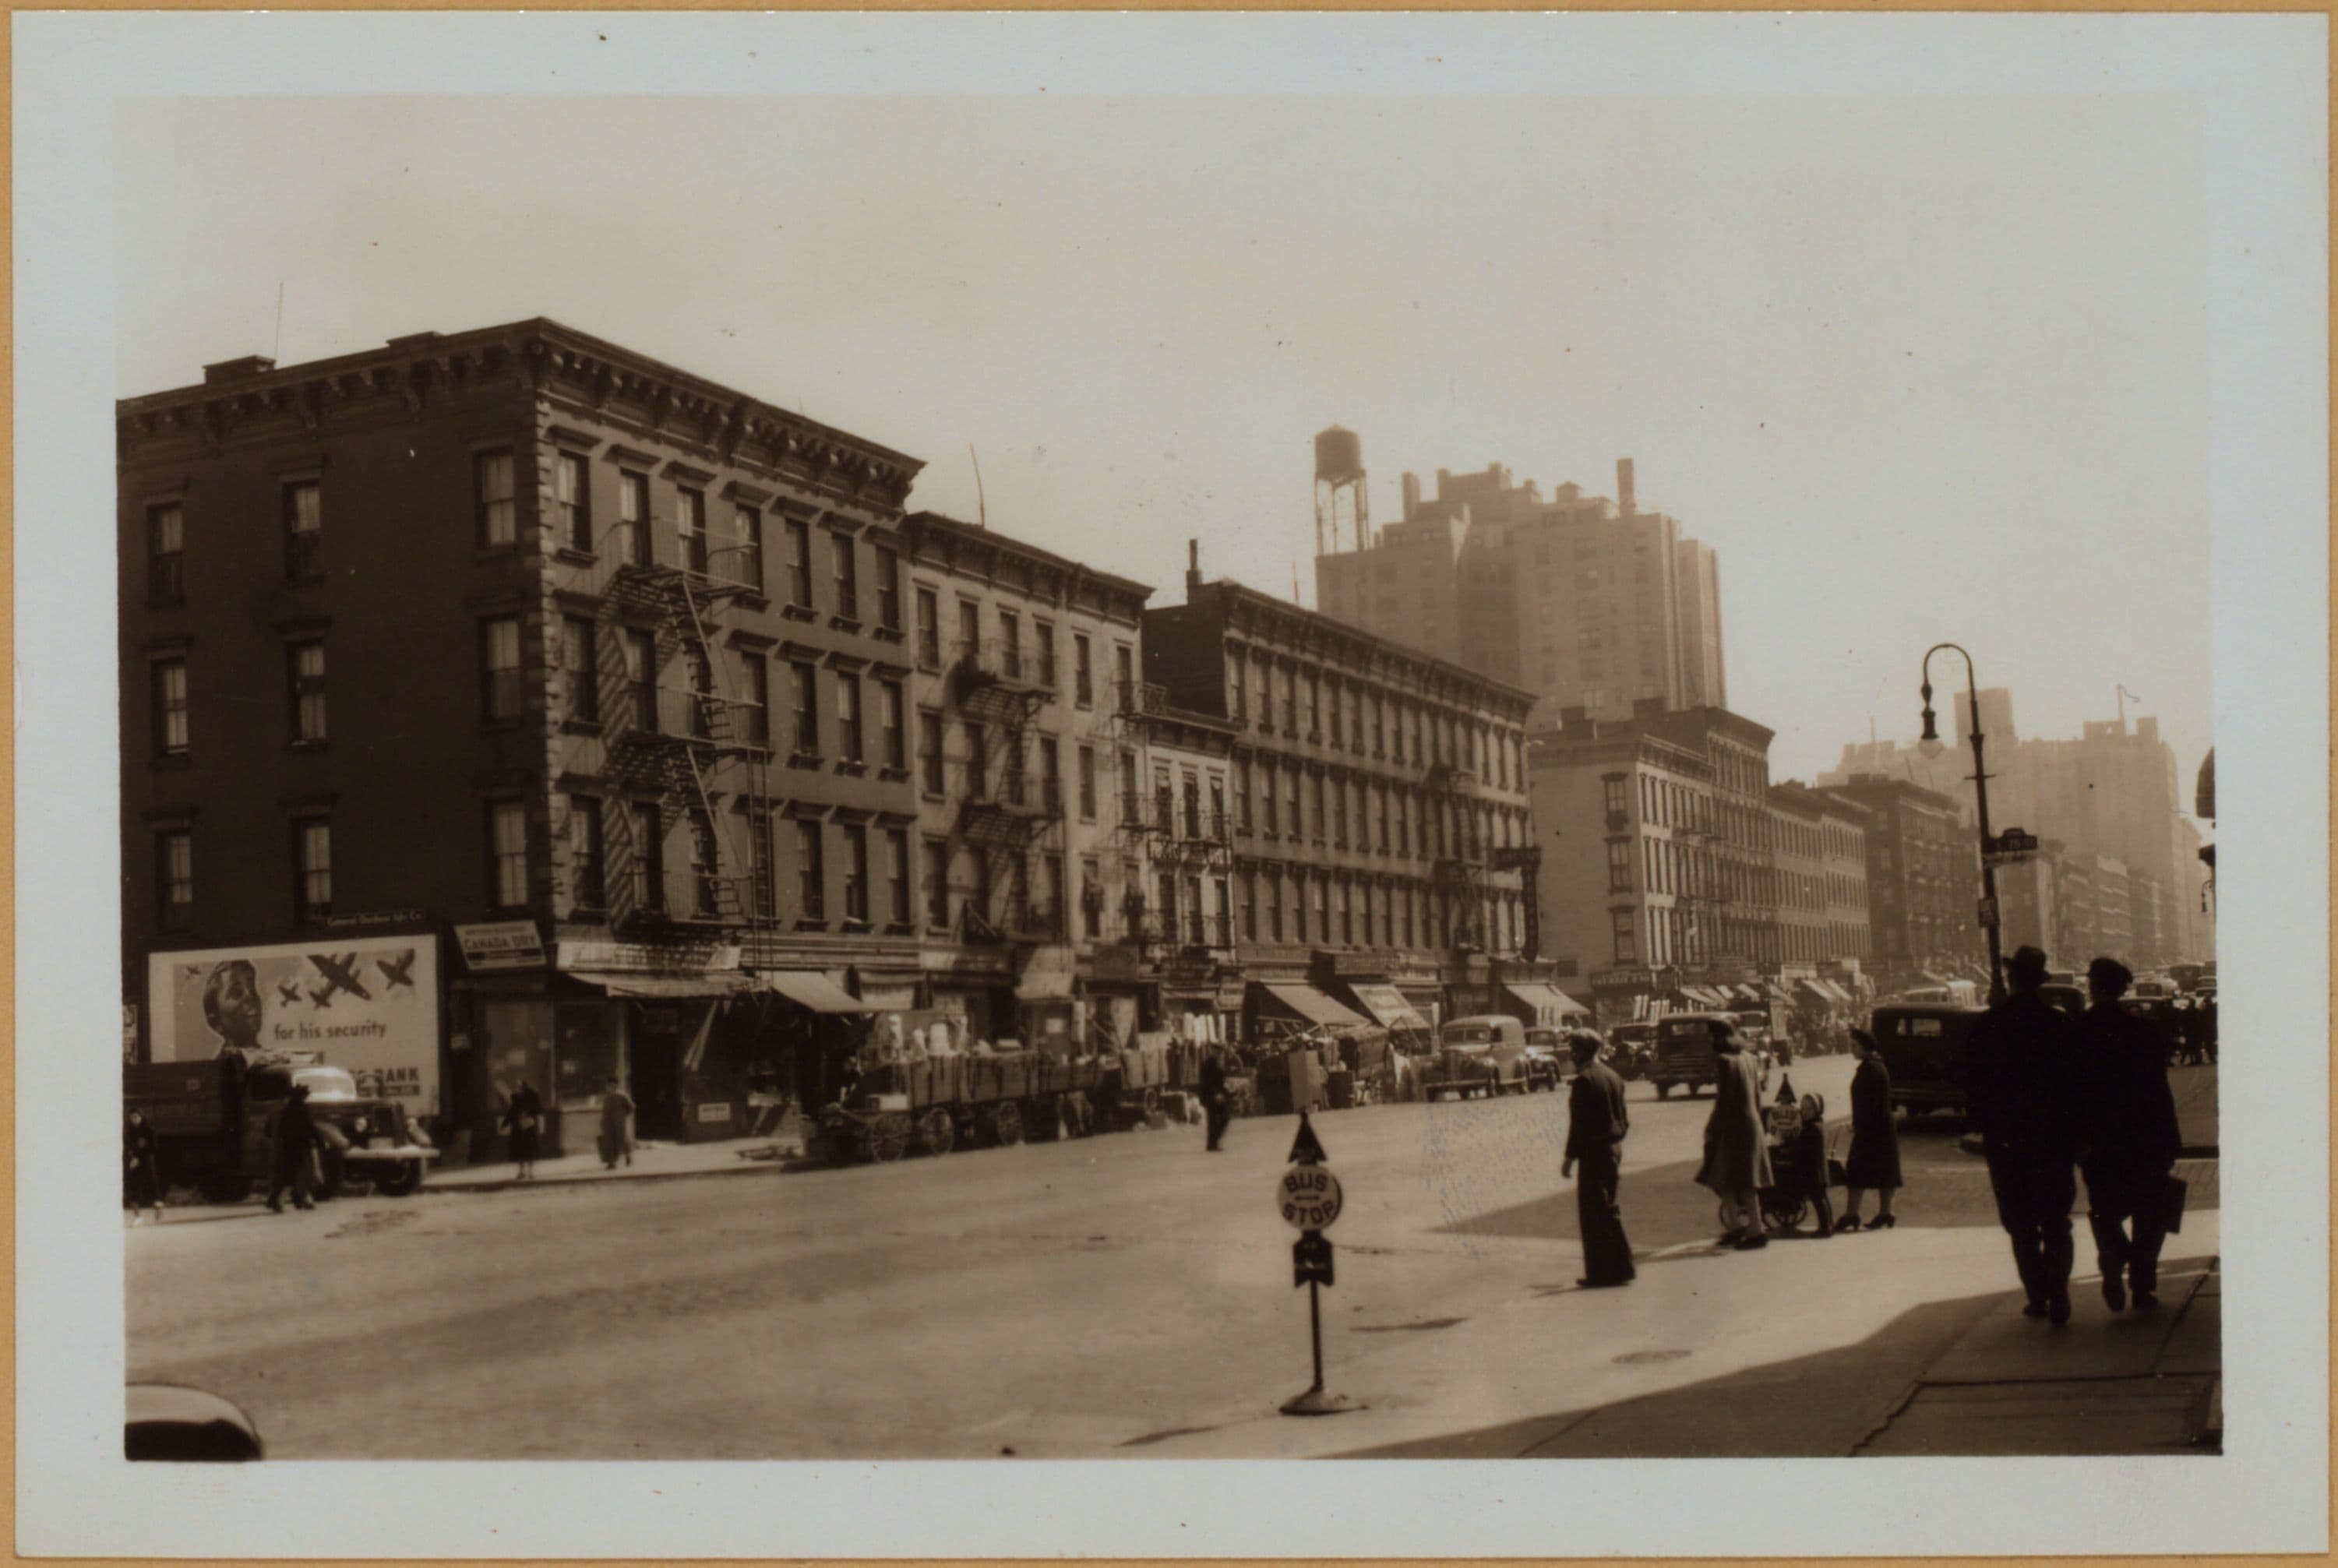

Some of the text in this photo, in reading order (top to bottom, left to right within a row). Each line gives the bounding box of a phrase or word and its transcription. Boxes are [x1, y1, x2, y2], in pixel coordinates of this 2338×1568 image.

[464, 935, 536, 948] CANADA DRY
[274, 1019, 386, 1040] for his security
[1284, 1172, 1328, 1193] BUS
[1282, 1200, 1334, 1224] STOP
